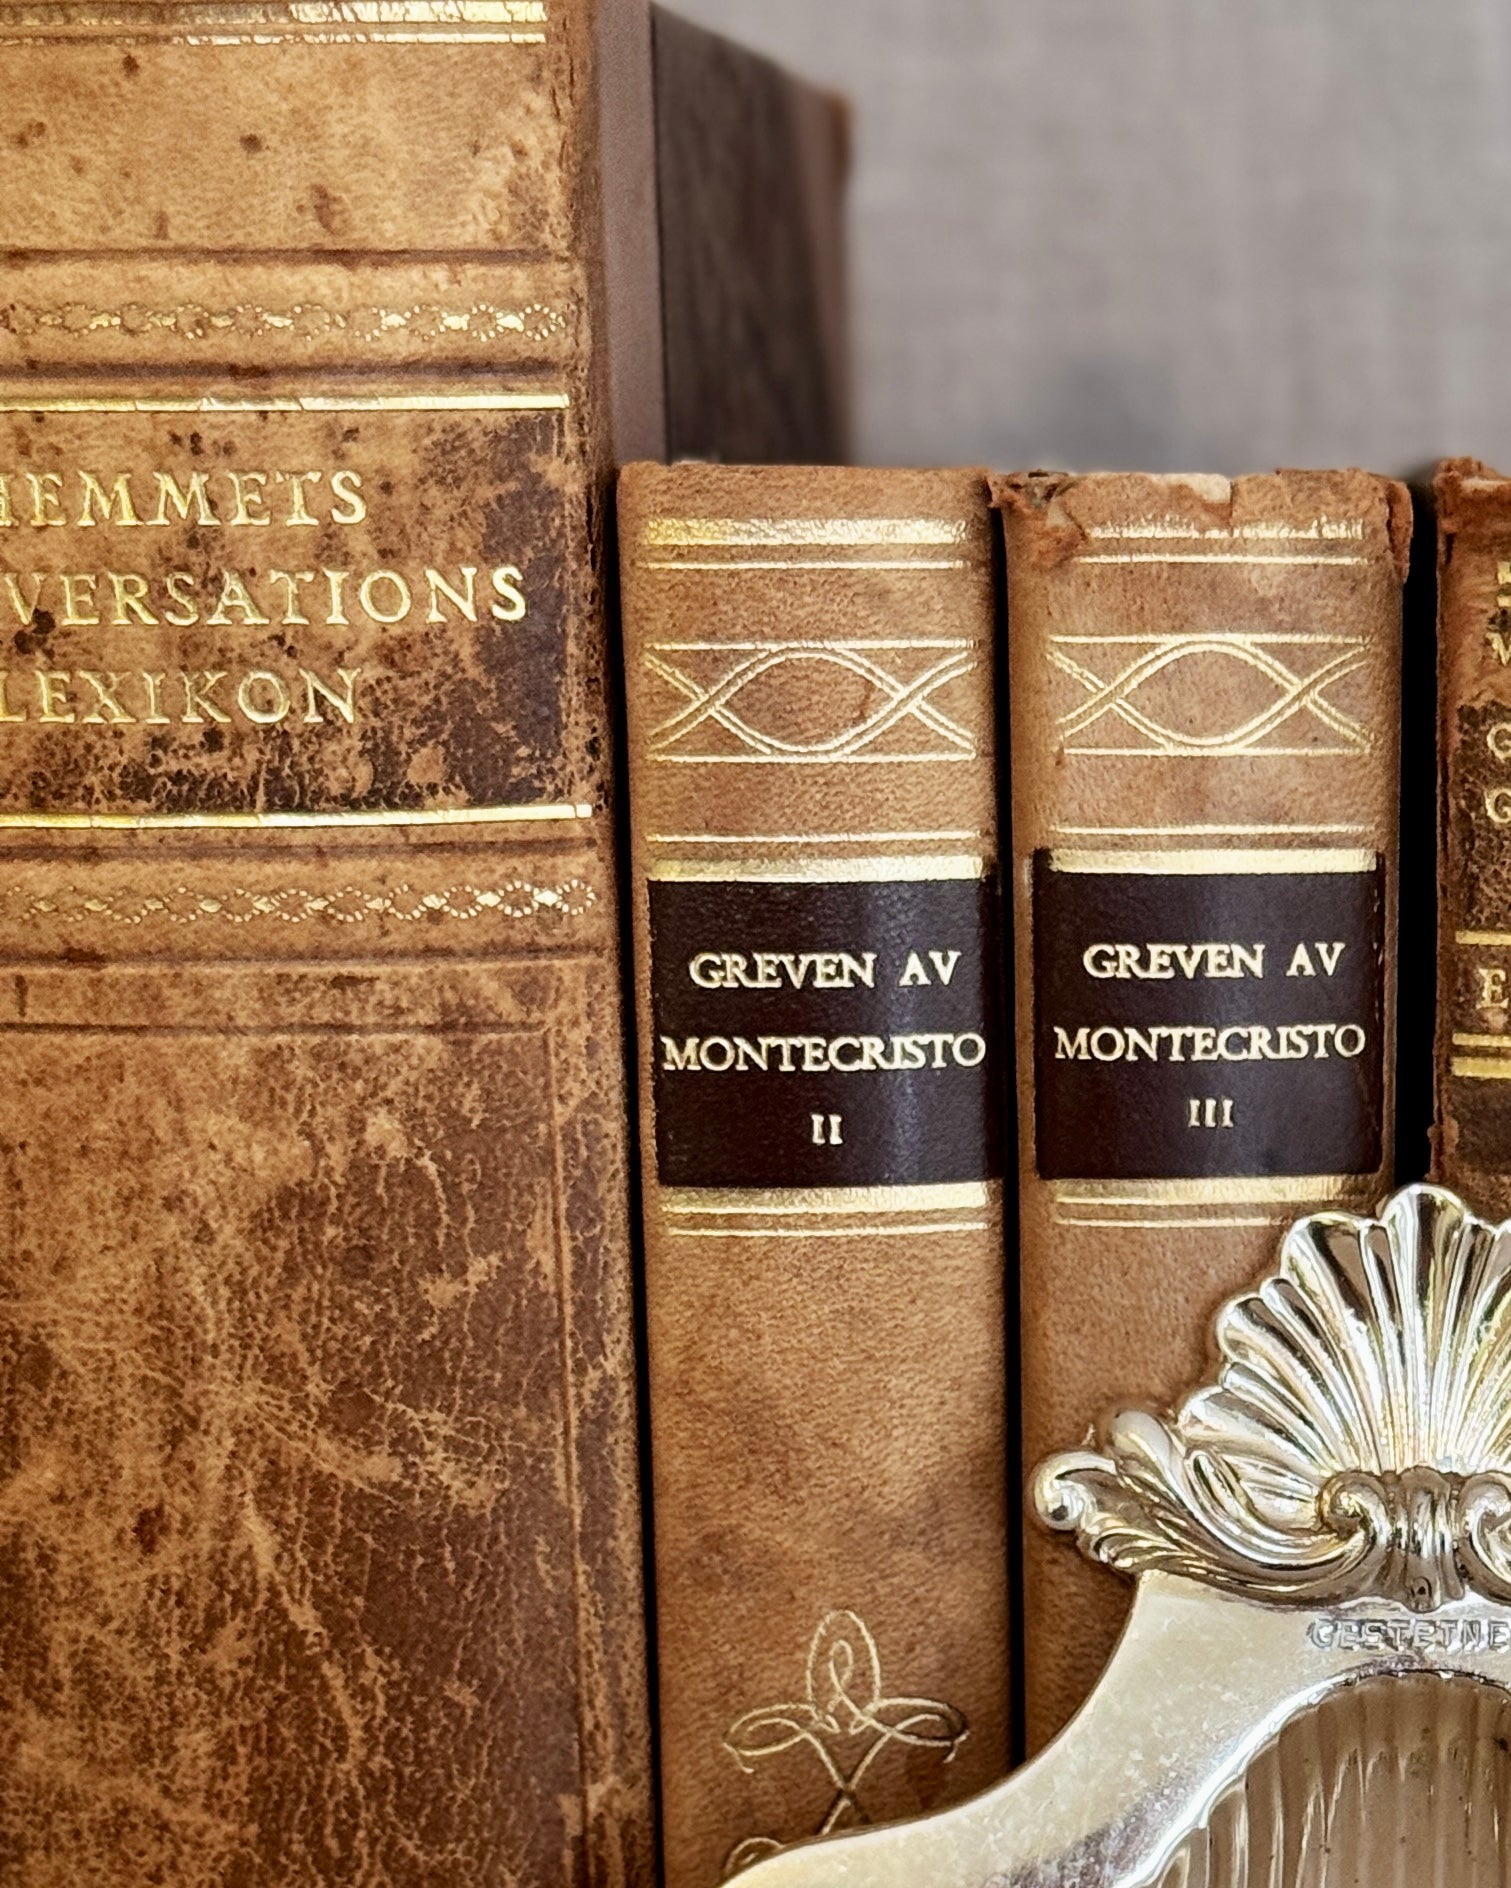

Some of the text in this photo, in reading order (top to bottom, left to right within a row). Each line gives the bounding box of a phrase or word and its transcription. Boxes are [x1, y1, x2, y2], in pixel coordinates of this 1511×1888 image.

[0, 666, 362, 725] LEXIKON
[688, 949, 961, 990] GREVEN AV
[1082, 942, 1346, 981] GREVEN AV
[660, 1032, 986, 1073] MONTECRISTO
[1053, 1024, 1366, 1063] MONTECRISTO
[811, 1113, 843, 1146] II
[1187, 1098, 1234, 1130] III
